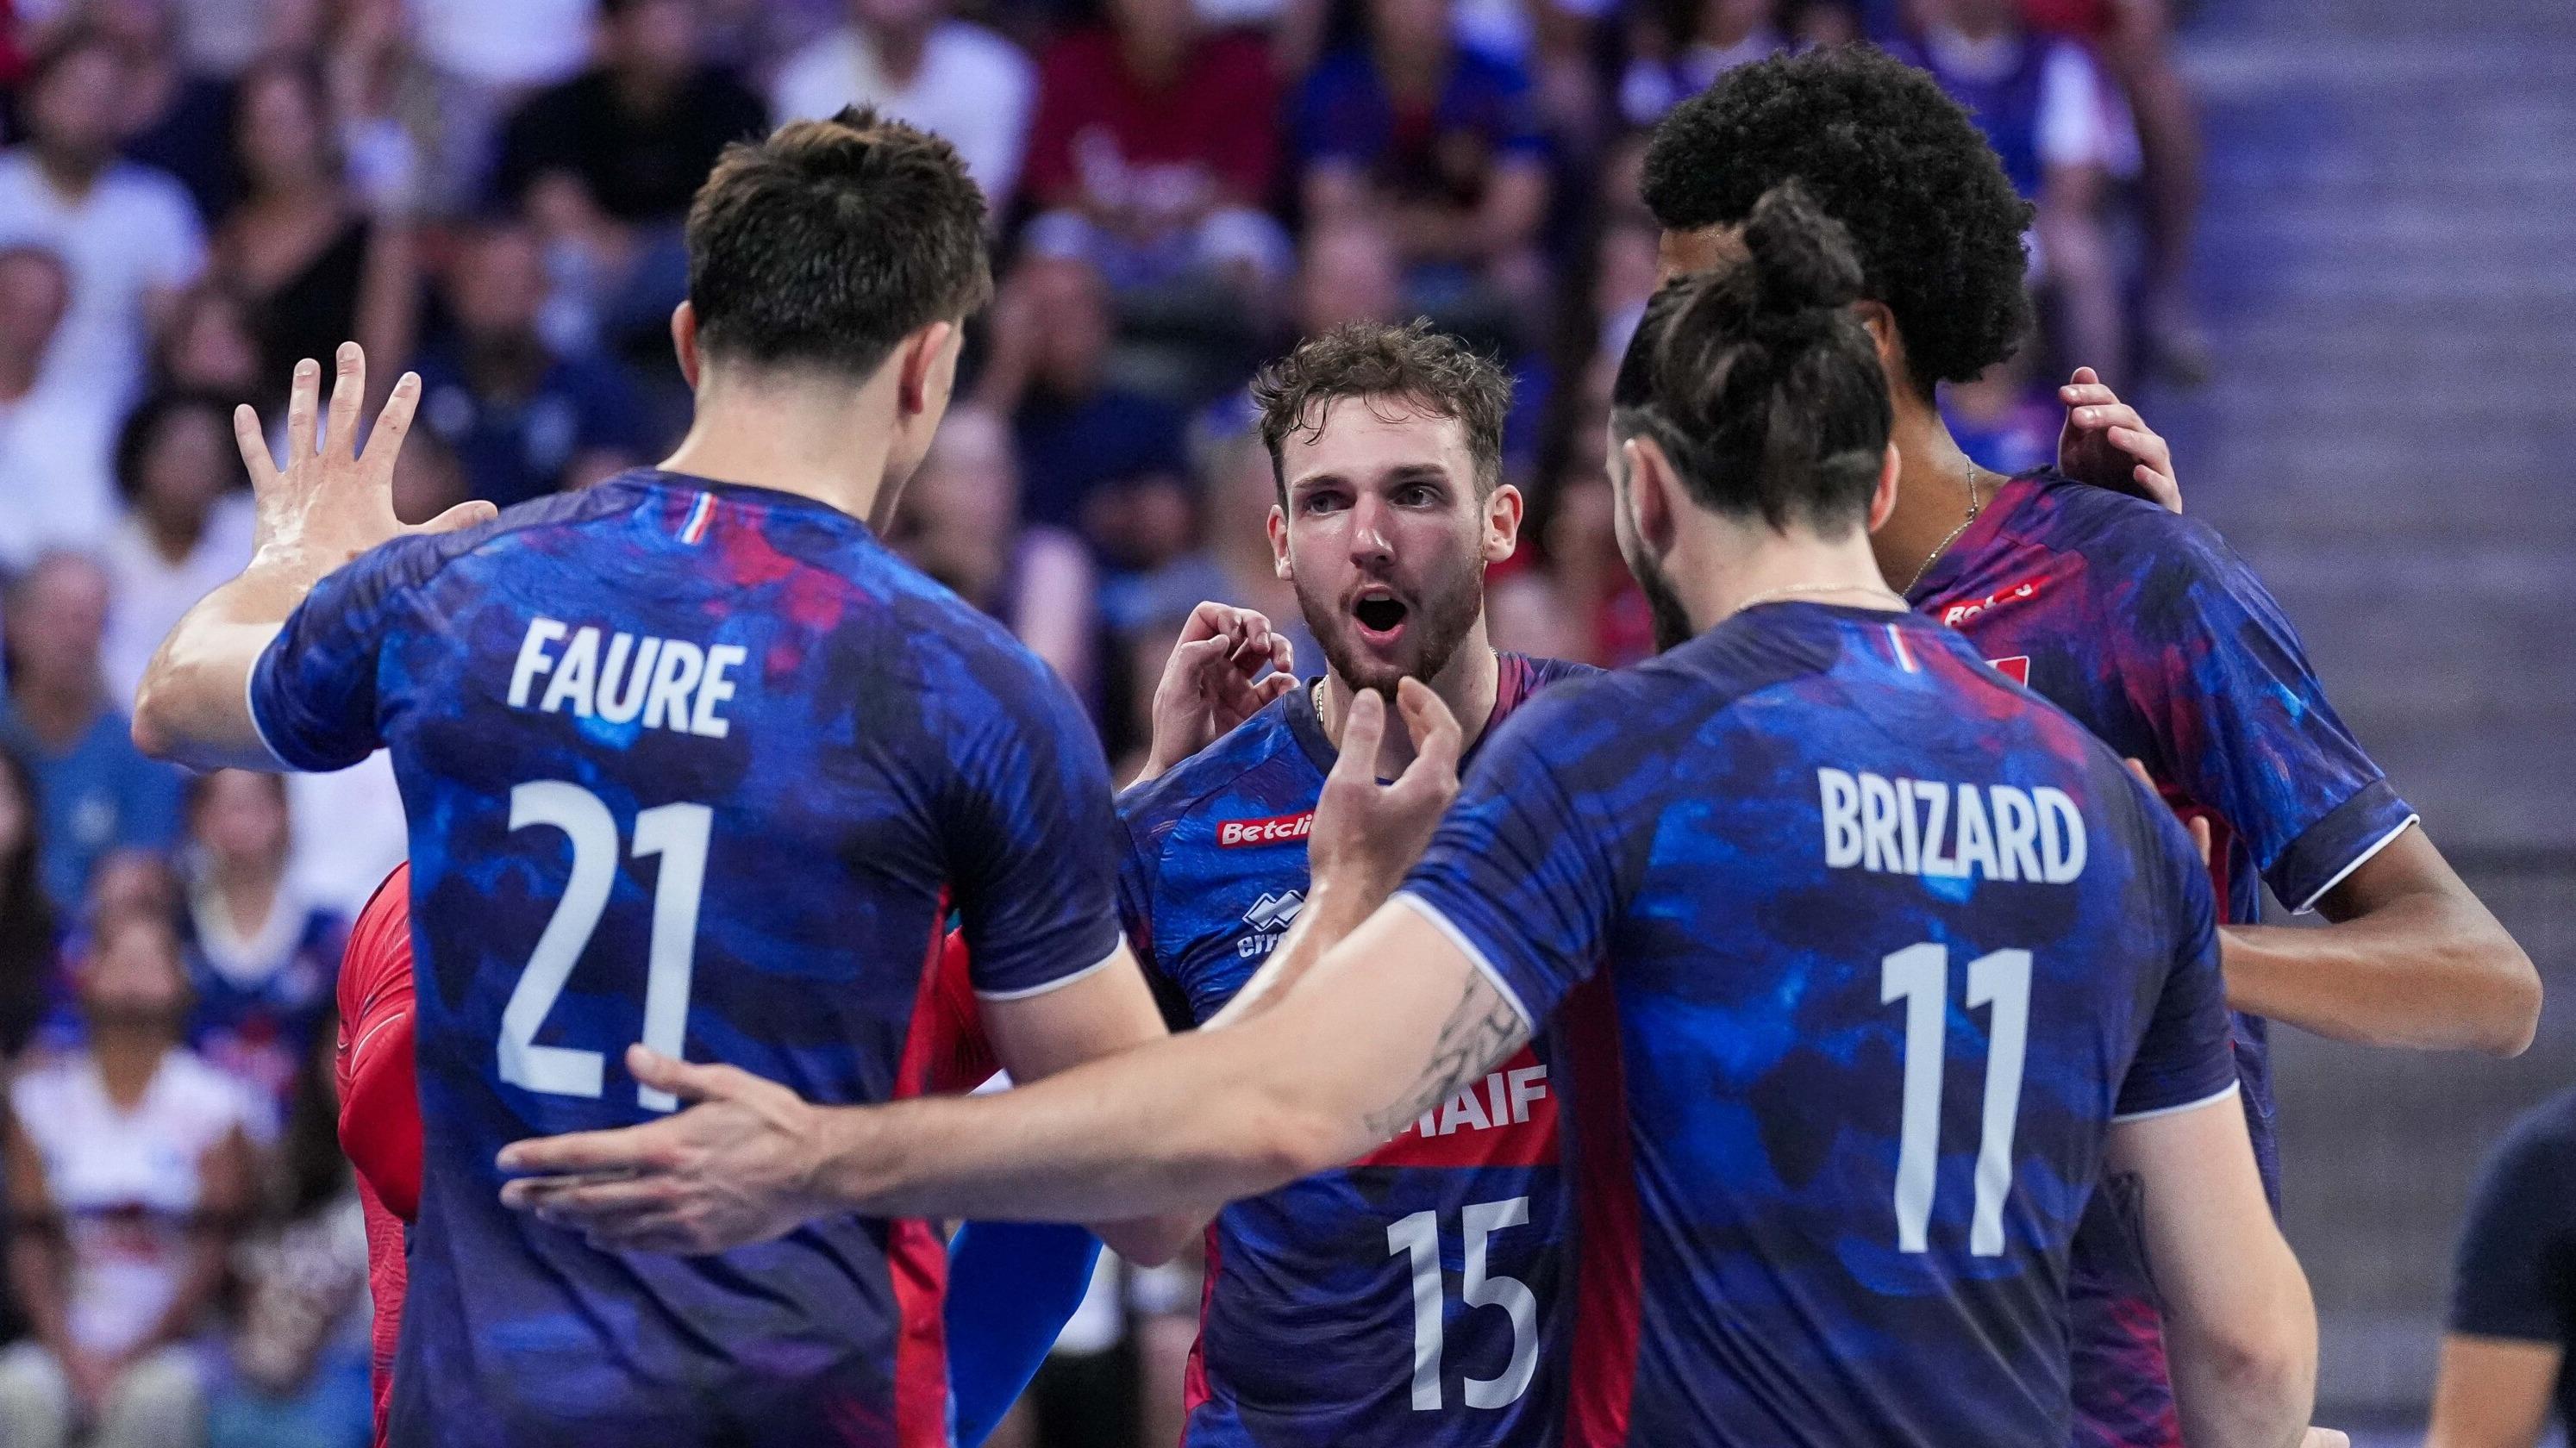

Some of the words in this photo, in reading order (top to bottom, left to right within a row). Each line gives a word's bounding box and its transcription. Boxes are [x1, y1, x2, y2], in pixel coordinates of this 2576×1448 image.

[507, 617, 747, 739] FAURE
[1222, 814, 1313, 845] Betcli
[1817, 767, 2087, 885] BRIZARD
[497, 779, 714, 1113] 21
[1237, 933, 1279, 958] err
[1382, 1064, 1547, 1143] AIF
[1880, 942, 2034, 1257] 11
[1386, 1195, 1539, 1411] 15
